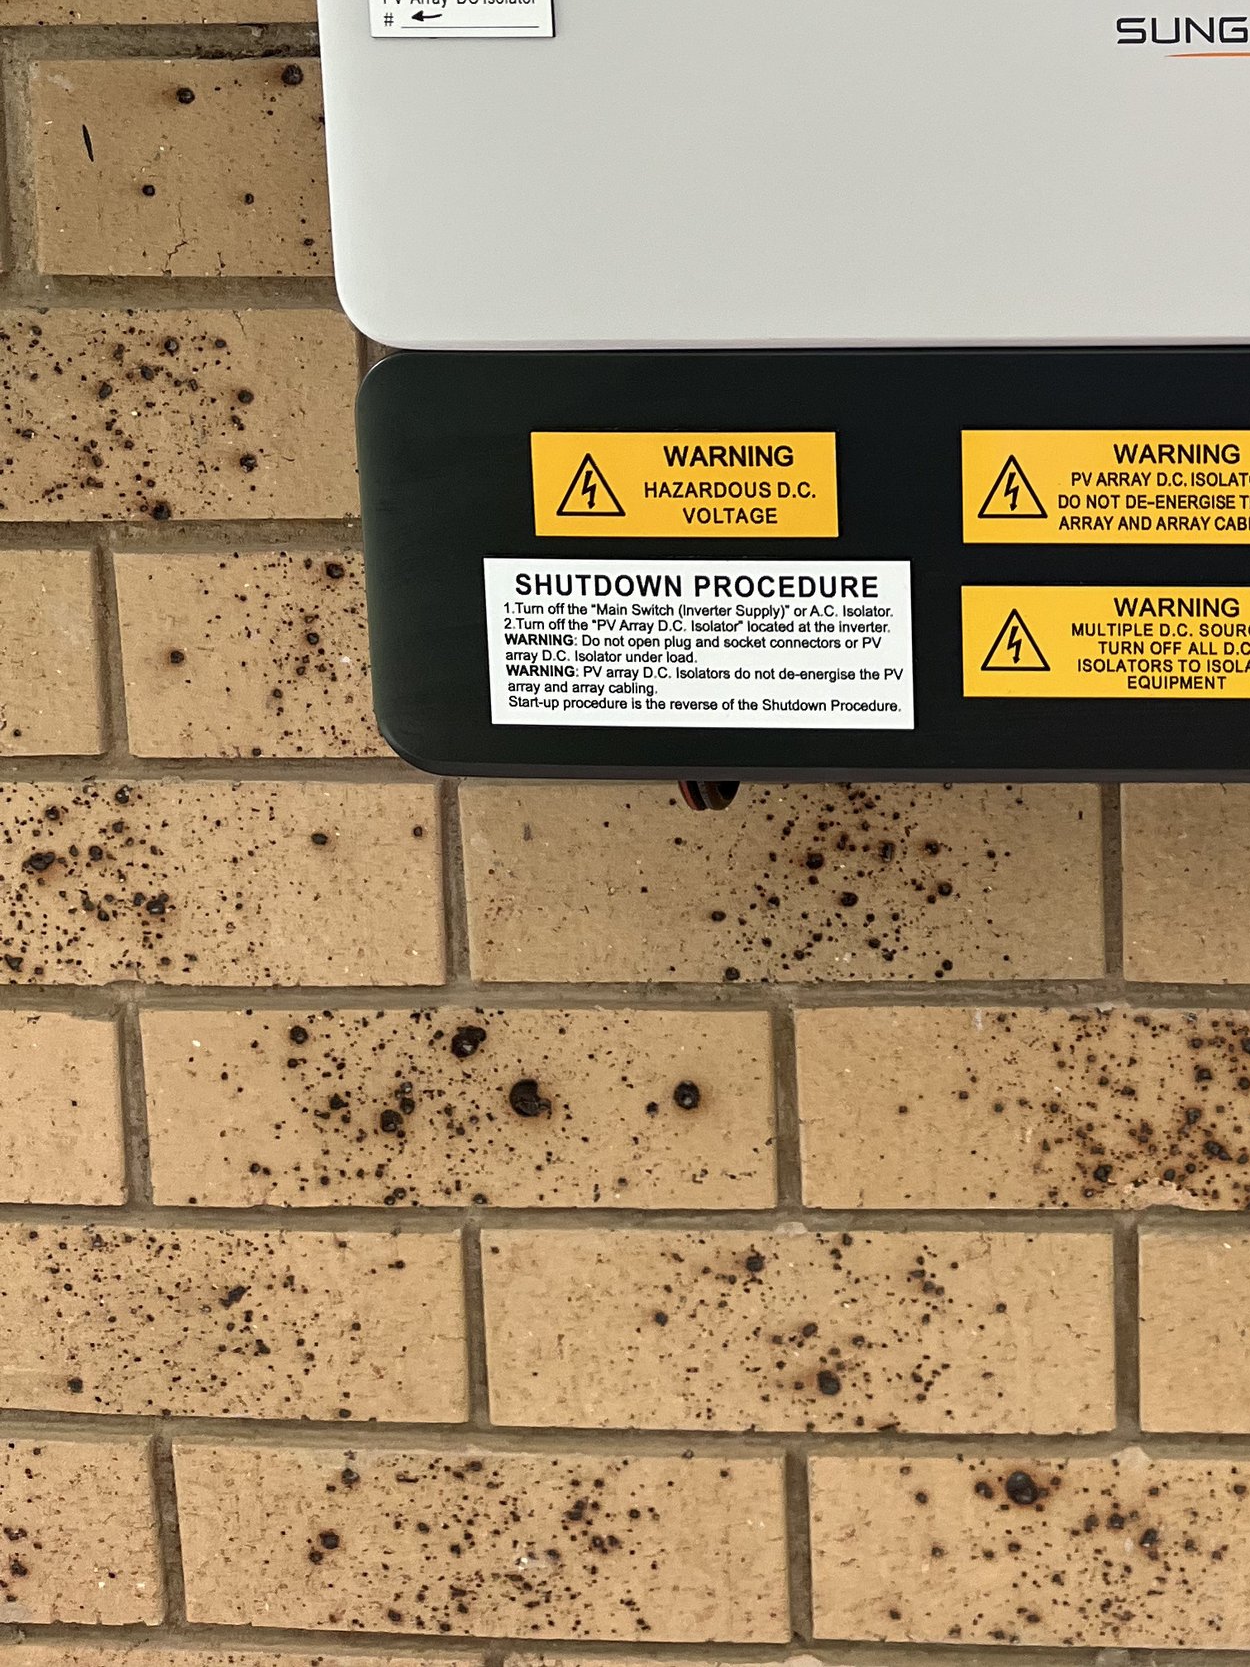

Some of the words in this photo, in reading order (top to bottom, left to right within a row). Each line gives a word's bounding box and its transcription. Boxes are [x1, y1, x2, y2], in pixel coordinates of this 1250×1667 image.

[664, 446, 793, 467] WARNING
[1114, 444, 1240, 464] WARNING
[1072, 472, 1092, 486] PV
[1096, 472, 1151, 486] ARRAY
[1157, 472, 1187, 486] D.C.
[645, 482, 771, 498] HAZARDOUS
[778, 482, 815, 498] D.C.
[1059, 495, 1080, 509] DO
[1087, 495, 1120, 509] NOT
[1126, 495, 1235, 509] DE-ENERGISE
[683, 508, 777, 524] VOLTAGE
[1059, 516, 1113, 530] ARRAY
[1118, 516, 1151, 530] AND
[1156, 516, 1210, 530] ARRAY
[516, 574, 681, 597] SHUTDOWN
[695, 576, 878, 598] PROCEDURE
[548, 603, 565, 614] off
[568, 603, 587, 615] the
[632, 604, 674, 616] Switch
[679, 604, 732, 618] (Inverter
[794, 608, 807, 616] or
[810, 605, 837, 617] A.C.
[843, 605, 893, 617] Isolator.
[1114, 598, 1239, 617] WARNING
[549, 619, 565, 630] off
[568, 619, 588, 630] the
[619, 620, 654, 633] Array
[658, 620, 686, 631] D.C.
[748, 620, 794, 632] located
[799, 621, 811, 632] at
[814, 621, 834, 632] the
[839, 621, 890, 633] inverter.
[1072, 623, 1153, 636] MULTIPLE
[1160, 623, 1192, 637] D.C.
[505, 633, 577, 646] WARNING:
[582, 635, 600, 646] Do
[604, 636, 624, 646] not
[628, 637, 660, 649] open
[665, 636, 691, 650] plug
[696, 636, 719, 647] and
[724, 636, 766, 648] socket
[770, 637, 841, 648] connectors
[845, 640, 858, 648] or
[863, 637, 881, 648] PV
[1098, 641, 1143, 654] TURN
[1150, 641, 1181, 655] OFF
[1188, 642, 1217, 655] ALL
[506, 652, 538, 665] array
[542, 650, 570, 662] D.C.
[575, 650, 622, 662] Isolator
[626, 651, 663, 662] under
[667, 651, 697, 663] load.
[1078, 659, 1173, 672] ISOLATORS
[1179, 660, 1200, 672] TO
[506, 665, 579, 677] WARNING:
[584, 666, 602, 677] PV
[607, 669, 639, 681] array
[644, 667, 671, 678] D.C.
[676, 667, 730, 679] Isolators
[735, 668, 750, 679] do
[755, 668, 775, 679] not
[779, 668, 855, 682] de-energise
[860, 669, 879, 680] the
[885, 669, 903, 680] PV
[508, 683, 540, 696] array
[545, 681, 567, 692] and
[573, 684, 604, 696] array
[609, 681, 657, 697] cabling.
[1128, 676, 1226, 689] EQUIPMENT
[509, 696, 559, 710] Start-up
[564, 697, 627, 711] procedure
[632, 698, 642, 709] is
[646, 698, 665, 709] the
[670, 701, 717, 710] reverse
[722, 699, 734, 710] of
[738, 699, 758, 710] the
[763, 699, 826, 711] Shutdown
[831, 700, 901, 711] Procedure.
